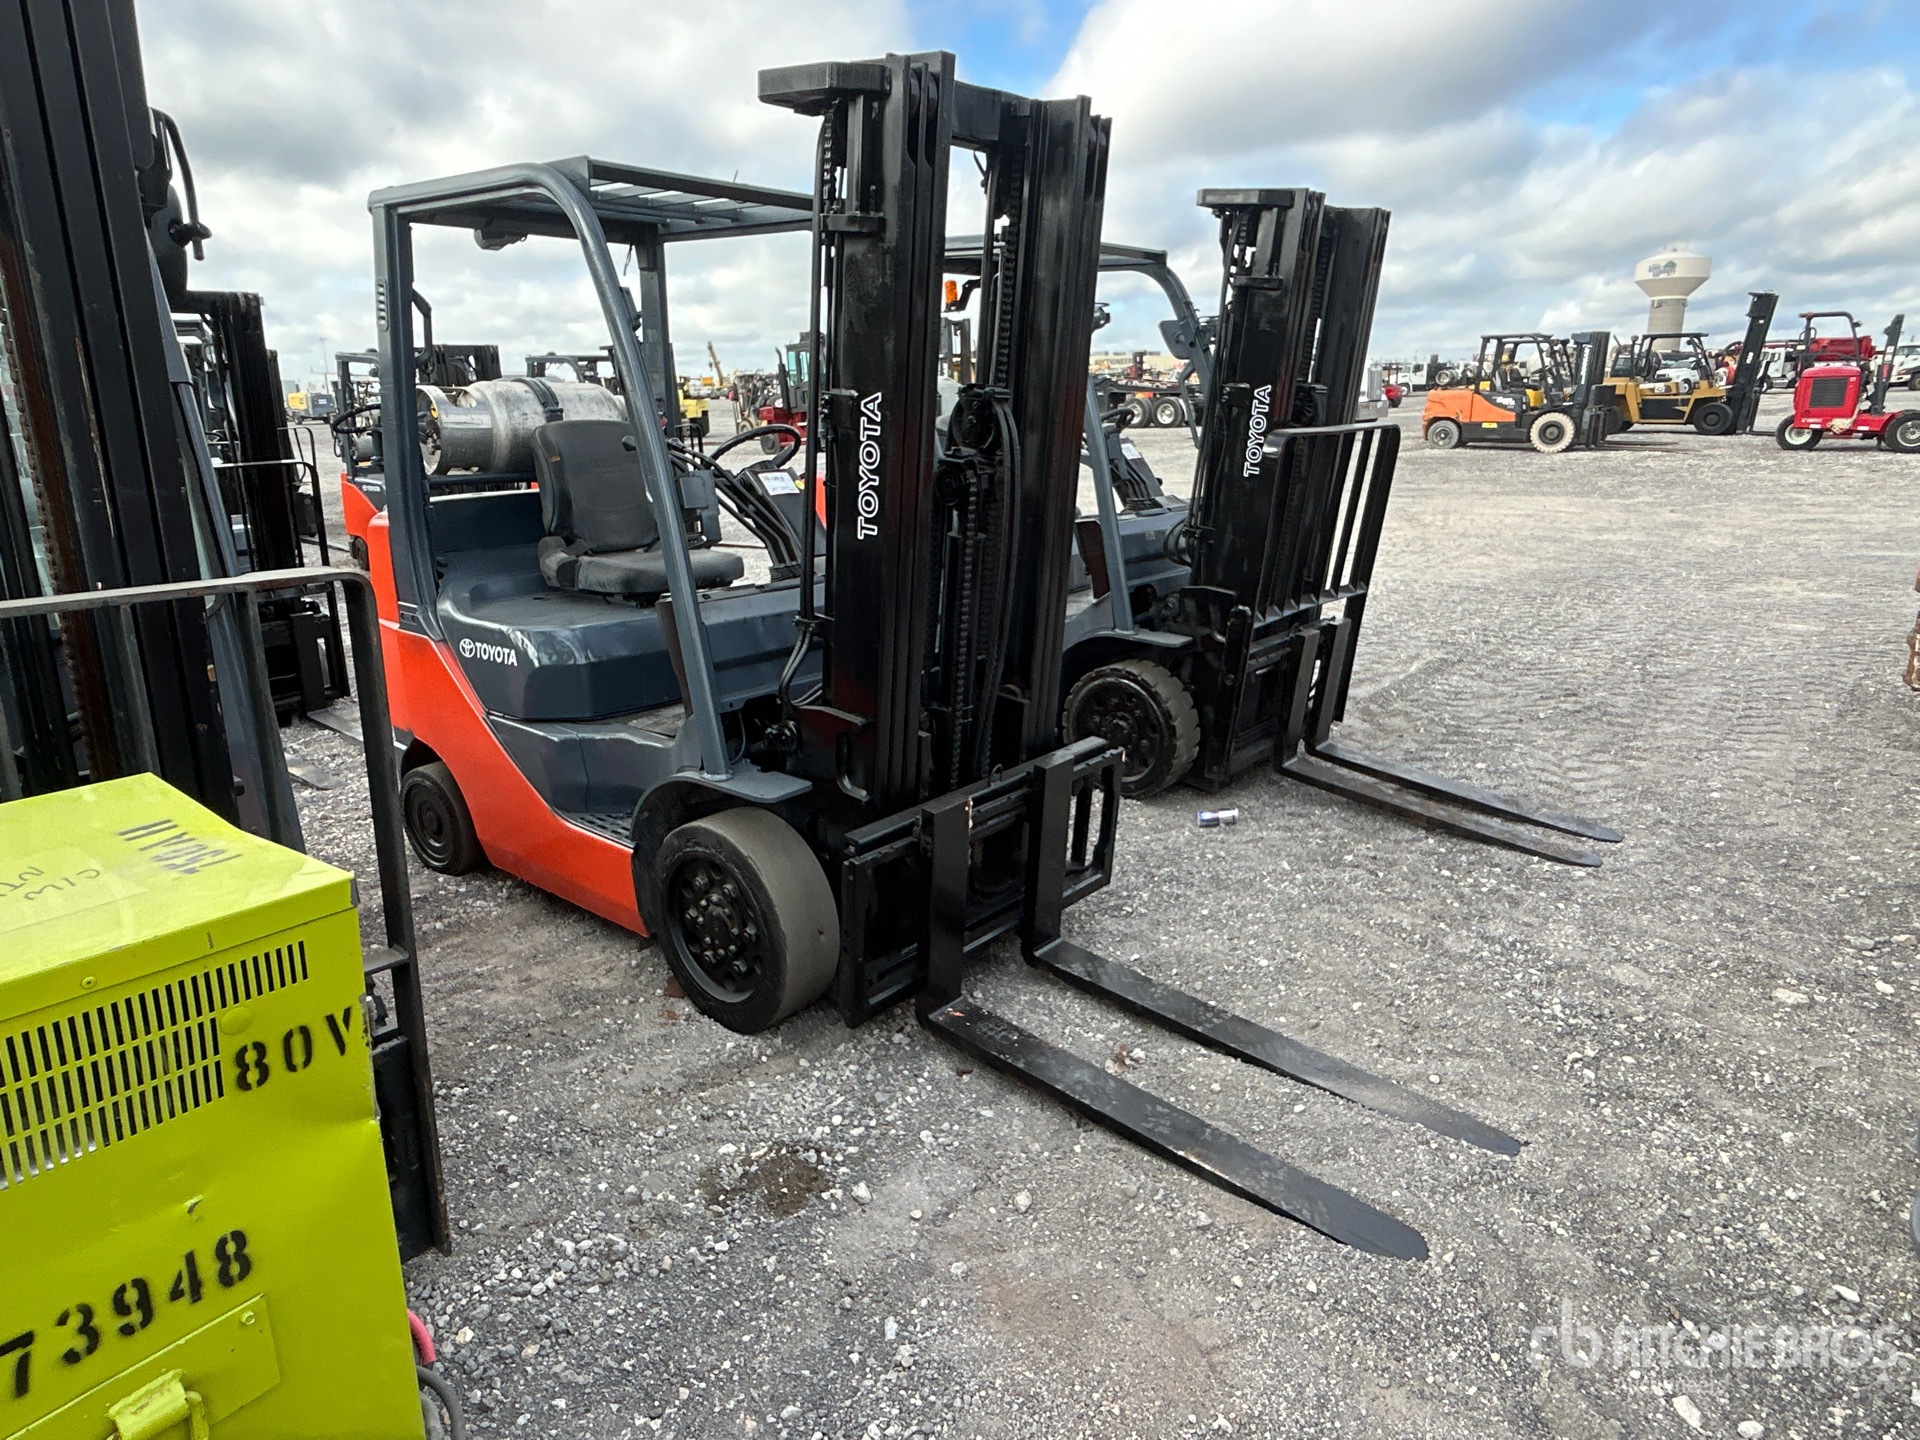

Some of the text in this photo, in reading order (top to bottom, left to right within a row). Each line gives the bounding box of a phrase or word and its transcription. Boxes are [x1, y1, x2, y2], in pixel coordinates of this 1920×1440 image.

[857, 391, 882, 540] TOYOTA
[1243, 384, 1272, 477] TOYOTA
[475, 642, 518, 667] TOYOTA
[234, 1005, 353, 1092] 80V
[0, 1229, 252, 1399] 73948
